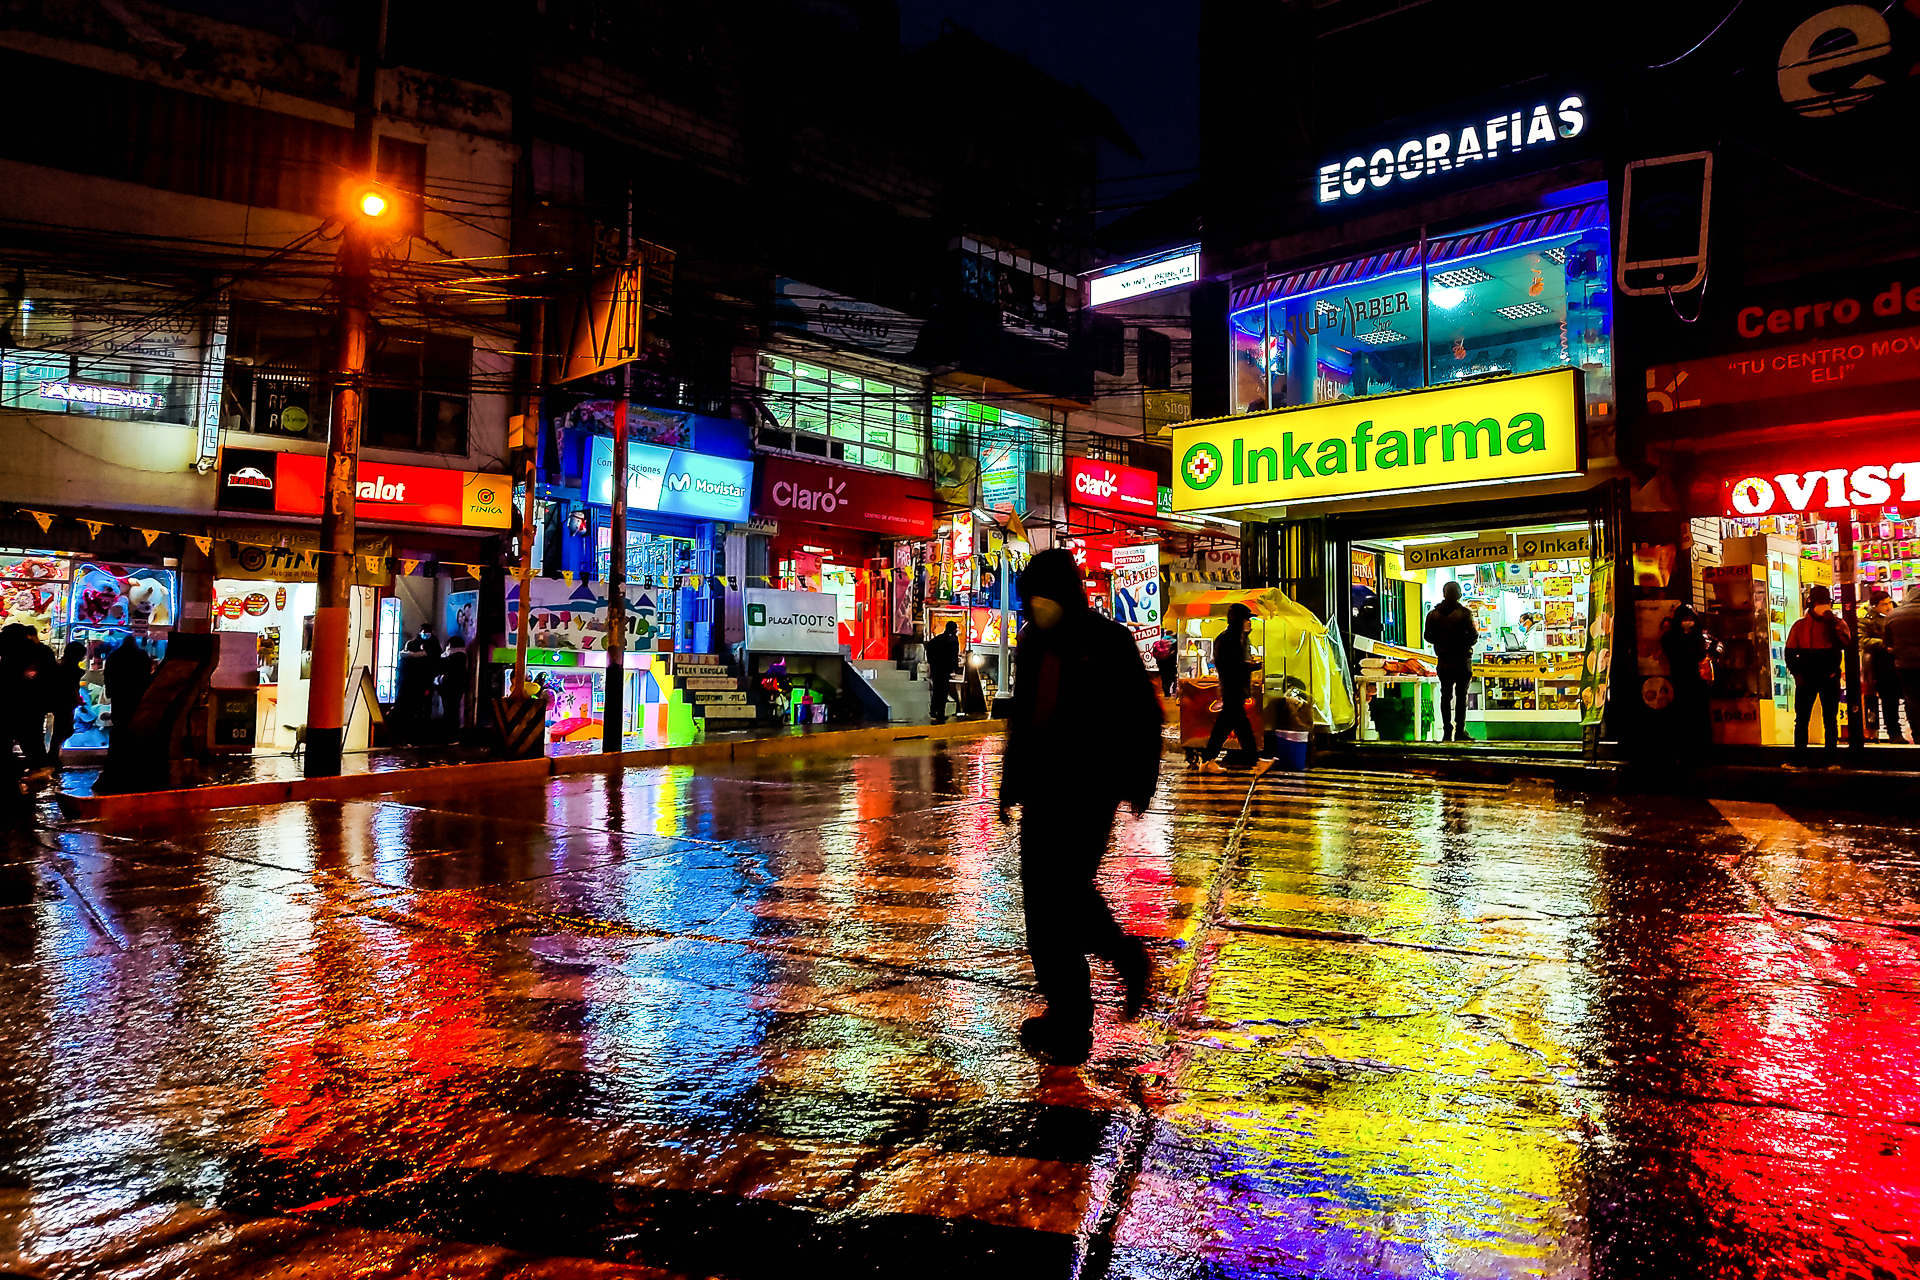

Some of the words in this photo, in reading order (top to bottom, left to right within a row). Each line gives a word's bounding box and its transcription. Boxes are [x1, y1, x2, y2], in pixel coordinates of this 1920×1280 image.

[1319, 96, 1584, 203] ECOGRAFIAS
[1326, 291, 1410, 336] BARBER
[1737, 297, 1861, 338] Cerro
[1772, 343, 1865, 371] CENTRO
[1231, 411, 1547, 487] Inkafarma
[239, 477, 271, 488] APUESTO
[695, 478, 746, 497] Movistar
[772, 480, 837, 513] Claro
[1075, 472, 1112, 497] Claro
[1425, 543, 1509, 563] Inkafarma
